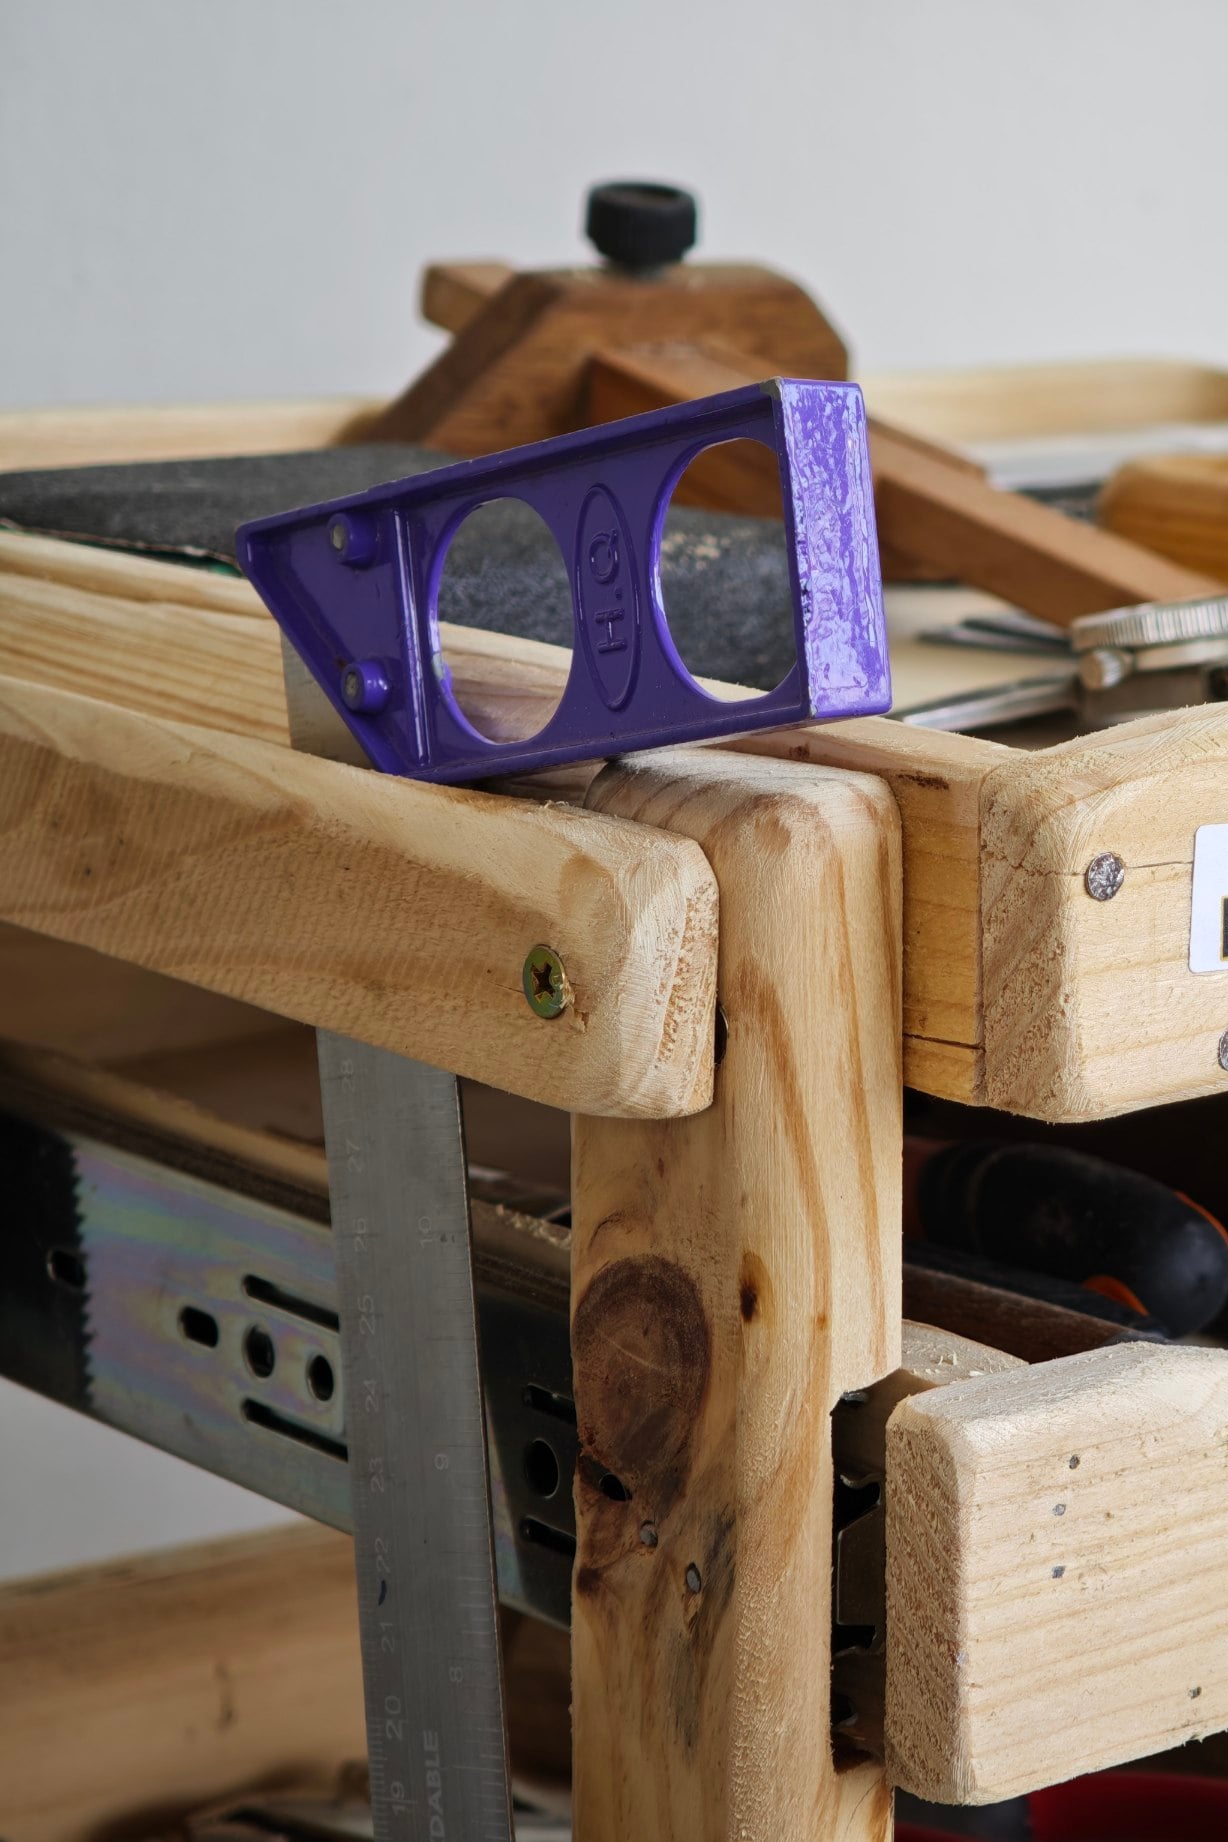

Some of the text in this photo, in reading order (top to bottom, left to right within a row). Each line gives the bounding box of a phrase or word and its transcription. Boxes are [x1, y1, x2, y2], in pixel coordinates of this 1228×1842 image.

[359, 1295, 376, 1336] 25
[369, 1456, 385, 1493] 23
[380, 1622, 396, 1654] 21
[384, 1695, 402, 1741] 20
[391, 1781, 407, 1817] 19
[423, 1730, 446, 1842] DABLE
